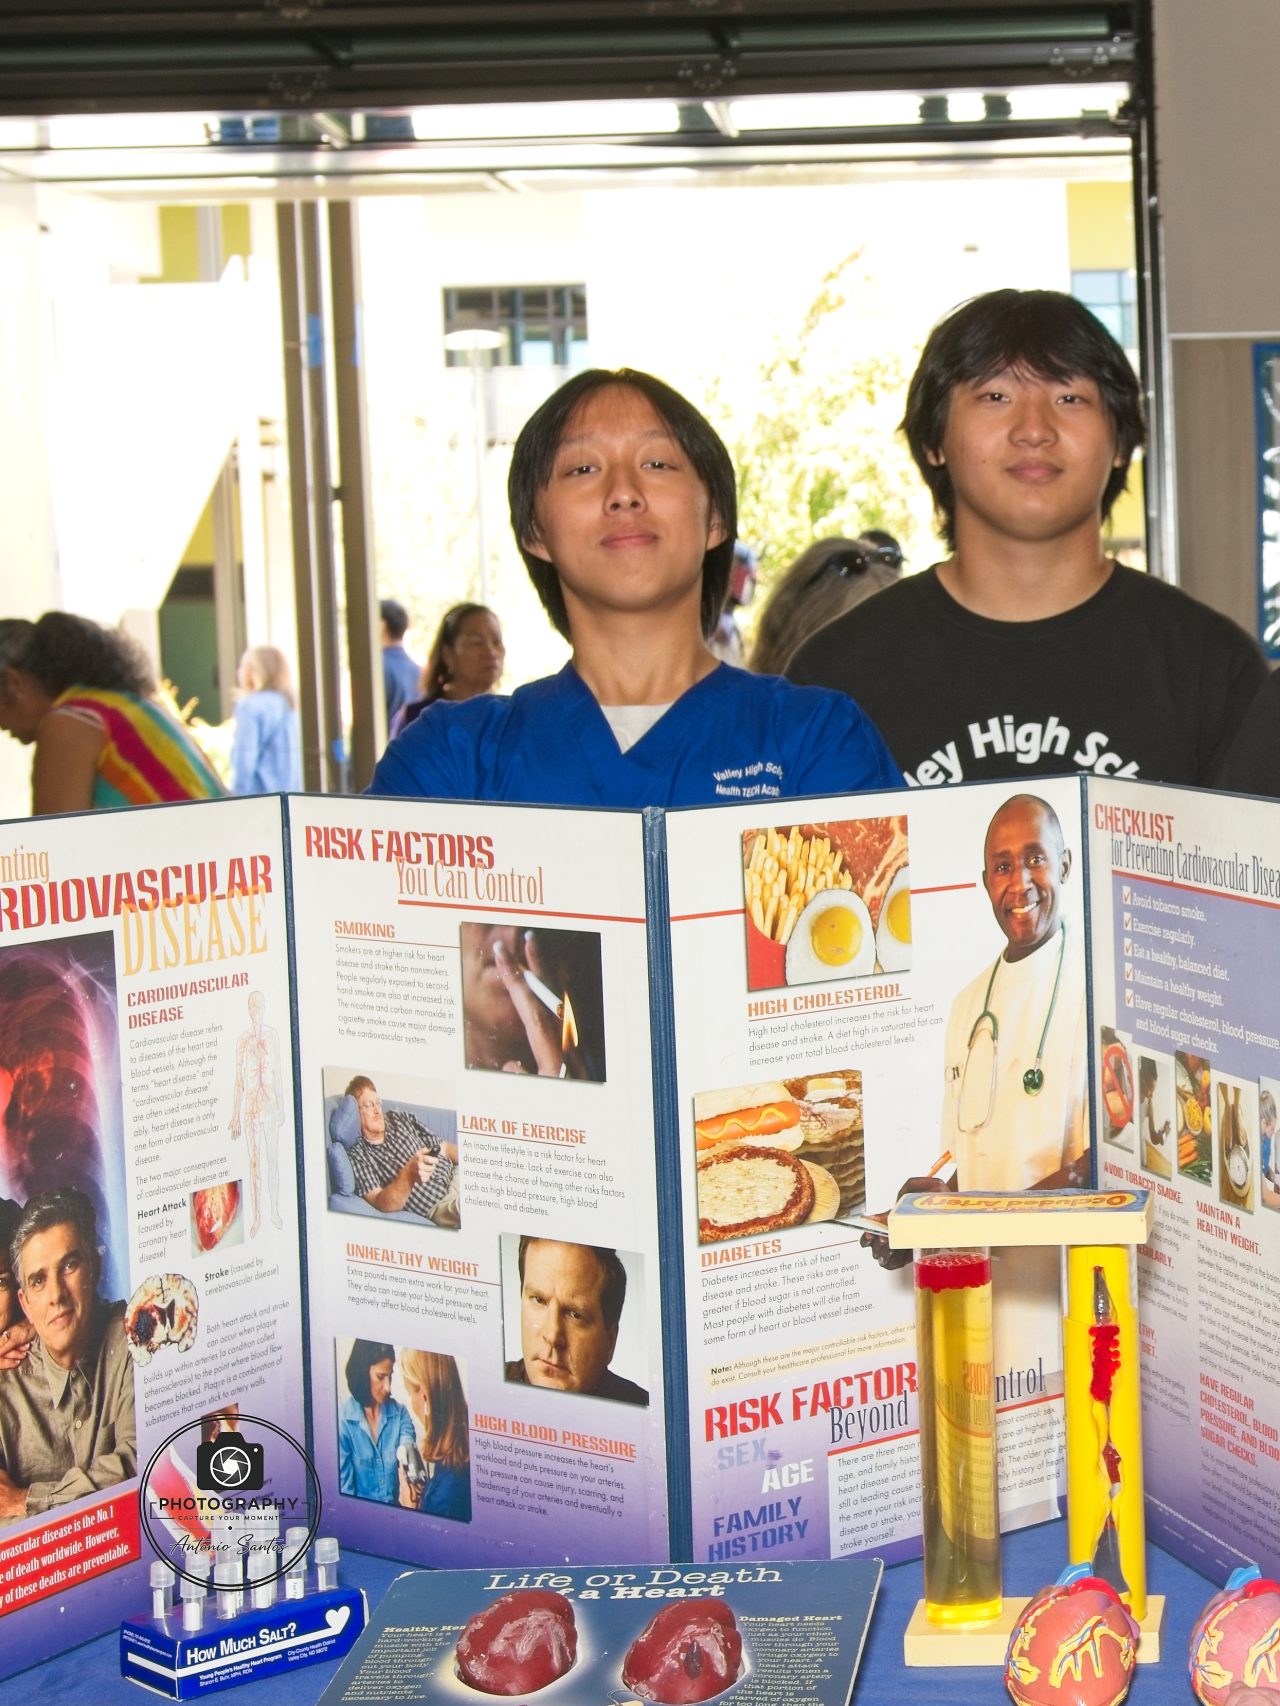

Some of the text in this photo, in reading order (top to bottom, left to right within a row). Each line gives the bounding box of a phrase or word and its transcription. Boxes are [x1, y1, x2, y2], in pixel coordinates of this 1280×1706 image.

[968, 715, 1070, 764] High
[713, 768, 743, 782] Valley
[745, 761, 763, 776] High
[716, 784, 740, 796] Health
[1094, 803, 1174, 842] CHECKLIST
[305, 825, 494, 869] RISK FACTORS
[1111, 832, 1124, 866] for
[1125, 835, 1174, 882] Preventing
[1177, 842, 1249, 892] Cardiovascular
[395, 856, 544, 905] You Can Control
[1153, 896, 1179, 916] tobacco
[1181, 904, 1206, 921] smoke.
[119, 885, 268, 976] DISEASE
[334, 920, 395, 938] SMOKING
[127, 972, 249, 1008] CARDIOVASCULAR
[748, 983, 902, 1017] HIGH CHOLESTEROL
[128, 1006, 184, 1029] DISEASE
[749, 1003, 934, 1038] High total cholesterol increases the risk for heart
[462, 1115, 586, 1144] LACK OF EXERCISE
[1104, 1161, 1184, 1205] AVOID TOBACCO SMOKE.
[137, 1199, 187, 1220] Heart Attack
[1197, 1200, 1240, 1229] MAINTAIN A
[701, 1239, 782, 1268] DIABETES
[1197, 1218, 1262, 1256] HEALTHY WEIGHT.
[205, 1268, 229, 1282] Stroke
[346, 1243, 479, 1277] UNHEALTHY WEIGHT
[705, 1362, 917, 1442] RISK FACTOR
[830, 1391, 908, 1444] Beyond
[474, 1414, 637, 1458] HIGH BLOOD PRESSURE
[718, 1438, 767, 1471] SEX
[762, 1459, 814, 1493] AGE
[42, 1523, 72, 1545] disease
[74, 1520, 81, 1532] is
[83, 1515, 95, 1528] the
[97, 1509, 108, 1523] No.
[110, 1505, 113, 1518] 1
[713, 1497, 802, 1536] FAMILY
[6, 1564, 14, 1581] of
[16, 1557, 39, 1575] death
[41, 1540, 84, 1567] worldwide.
[85, 1527, 119, 1550] However,
[708, 1520, 809, 1563] HISTORY
[6, 1543, 130, 1604] of these deaths are preventable.
[484, 1567, 783, 1590] Life or Death
[575, 1584, 726, 1599] a Heart
